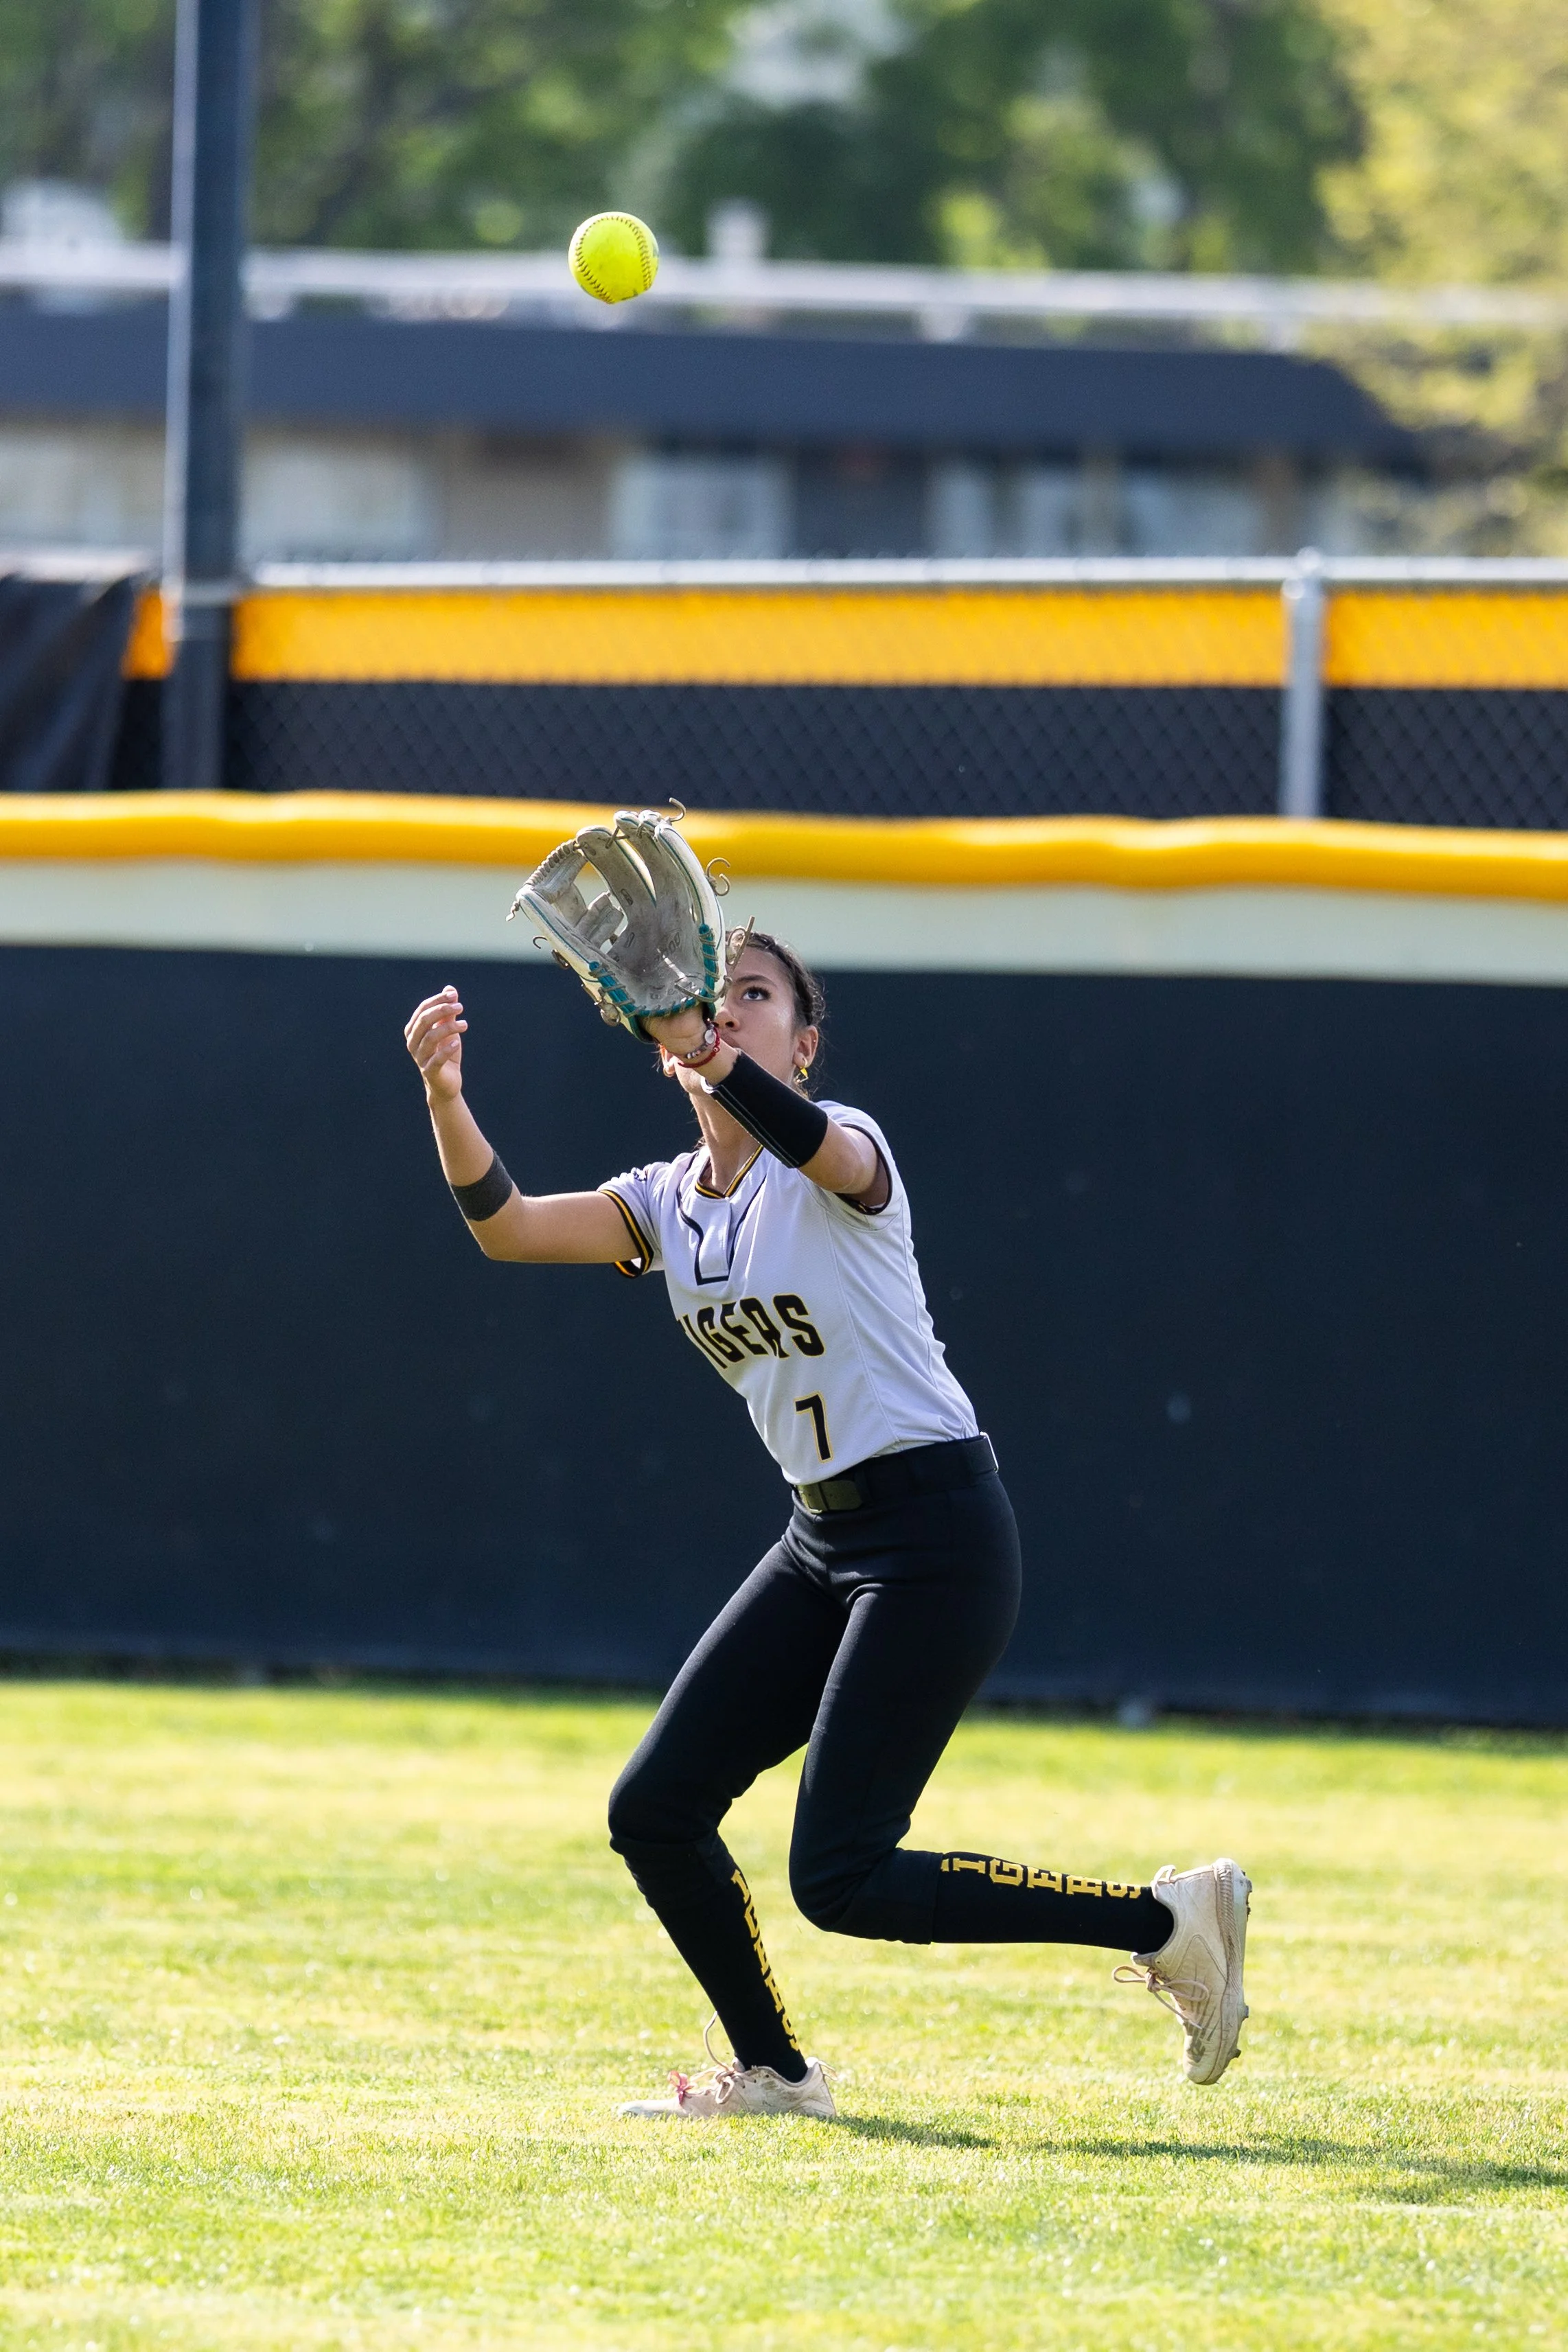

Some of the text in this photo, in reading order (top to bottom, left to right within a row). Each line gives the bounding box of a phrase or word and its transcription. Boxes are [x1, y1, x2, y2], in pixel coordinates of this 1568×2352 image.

[677, 1293, 825, 1369] IGERS
[794, 1391, 833, 1463] 7
[941, 1858, 1141, 1899] IGERS
